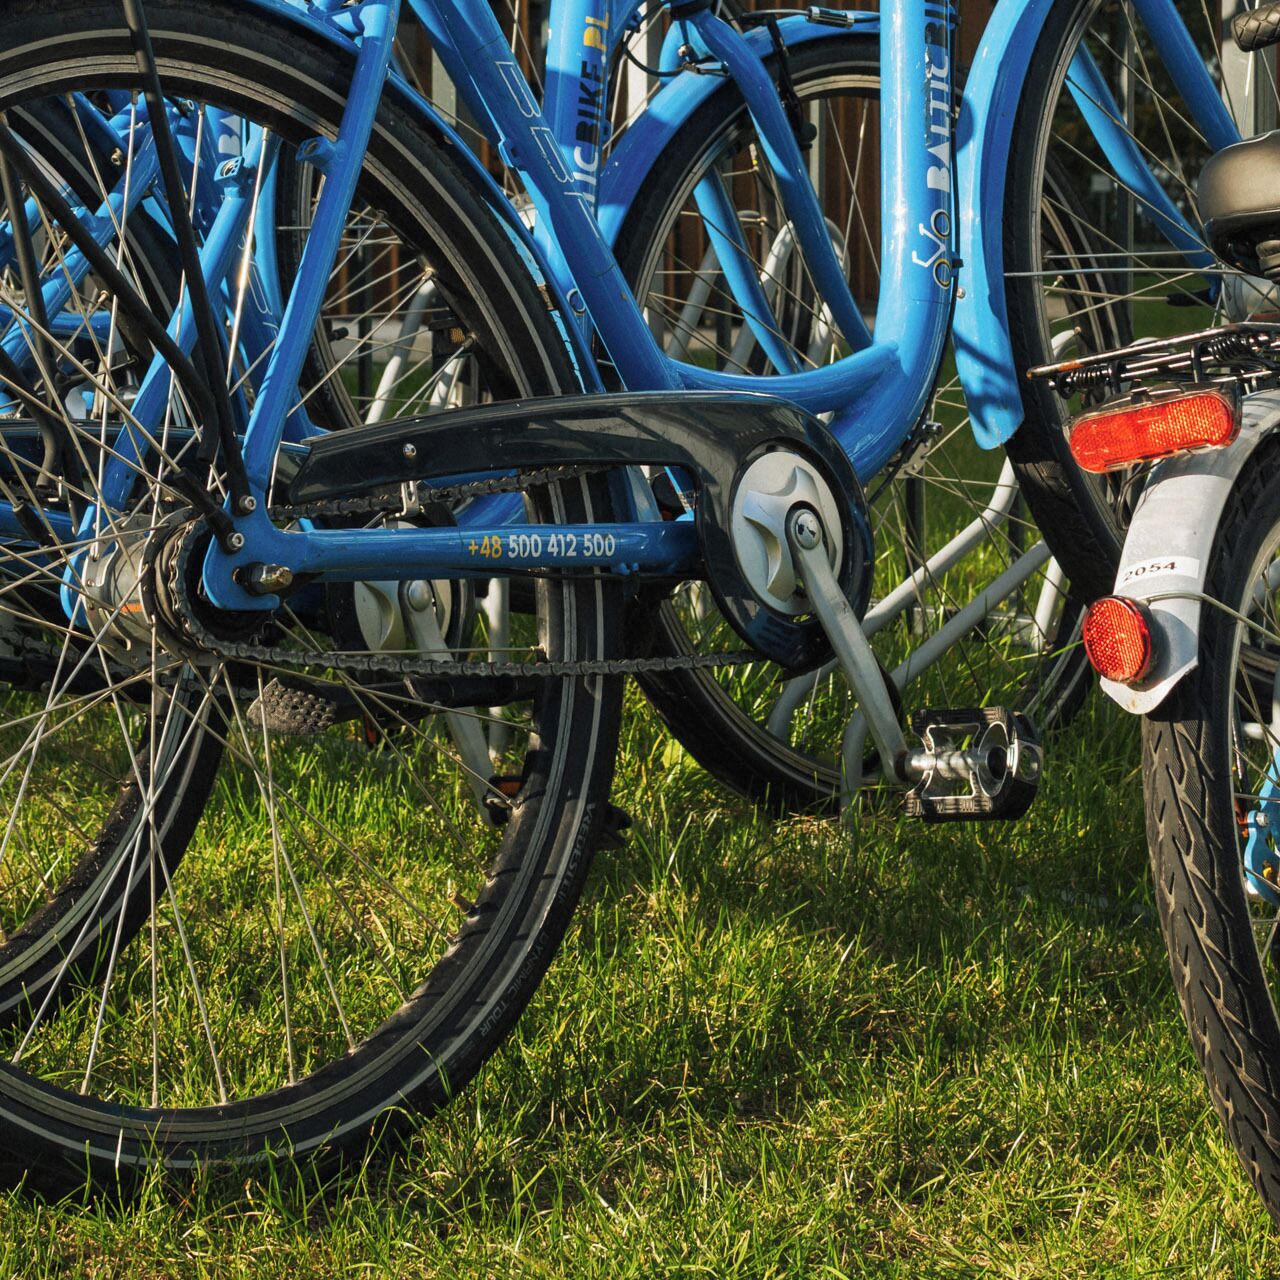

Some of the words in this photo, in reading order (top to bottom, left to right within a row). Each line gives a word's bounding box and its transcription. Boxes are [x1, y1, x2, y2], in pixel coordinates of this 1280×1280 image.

[468, 535, 502, 559] +48
[508, 533, 542, 559] 500
[547, 533, 577, 557] 412
[583, 532, 616, 557] 500
[1123, 561, 1177, 582] 2054
